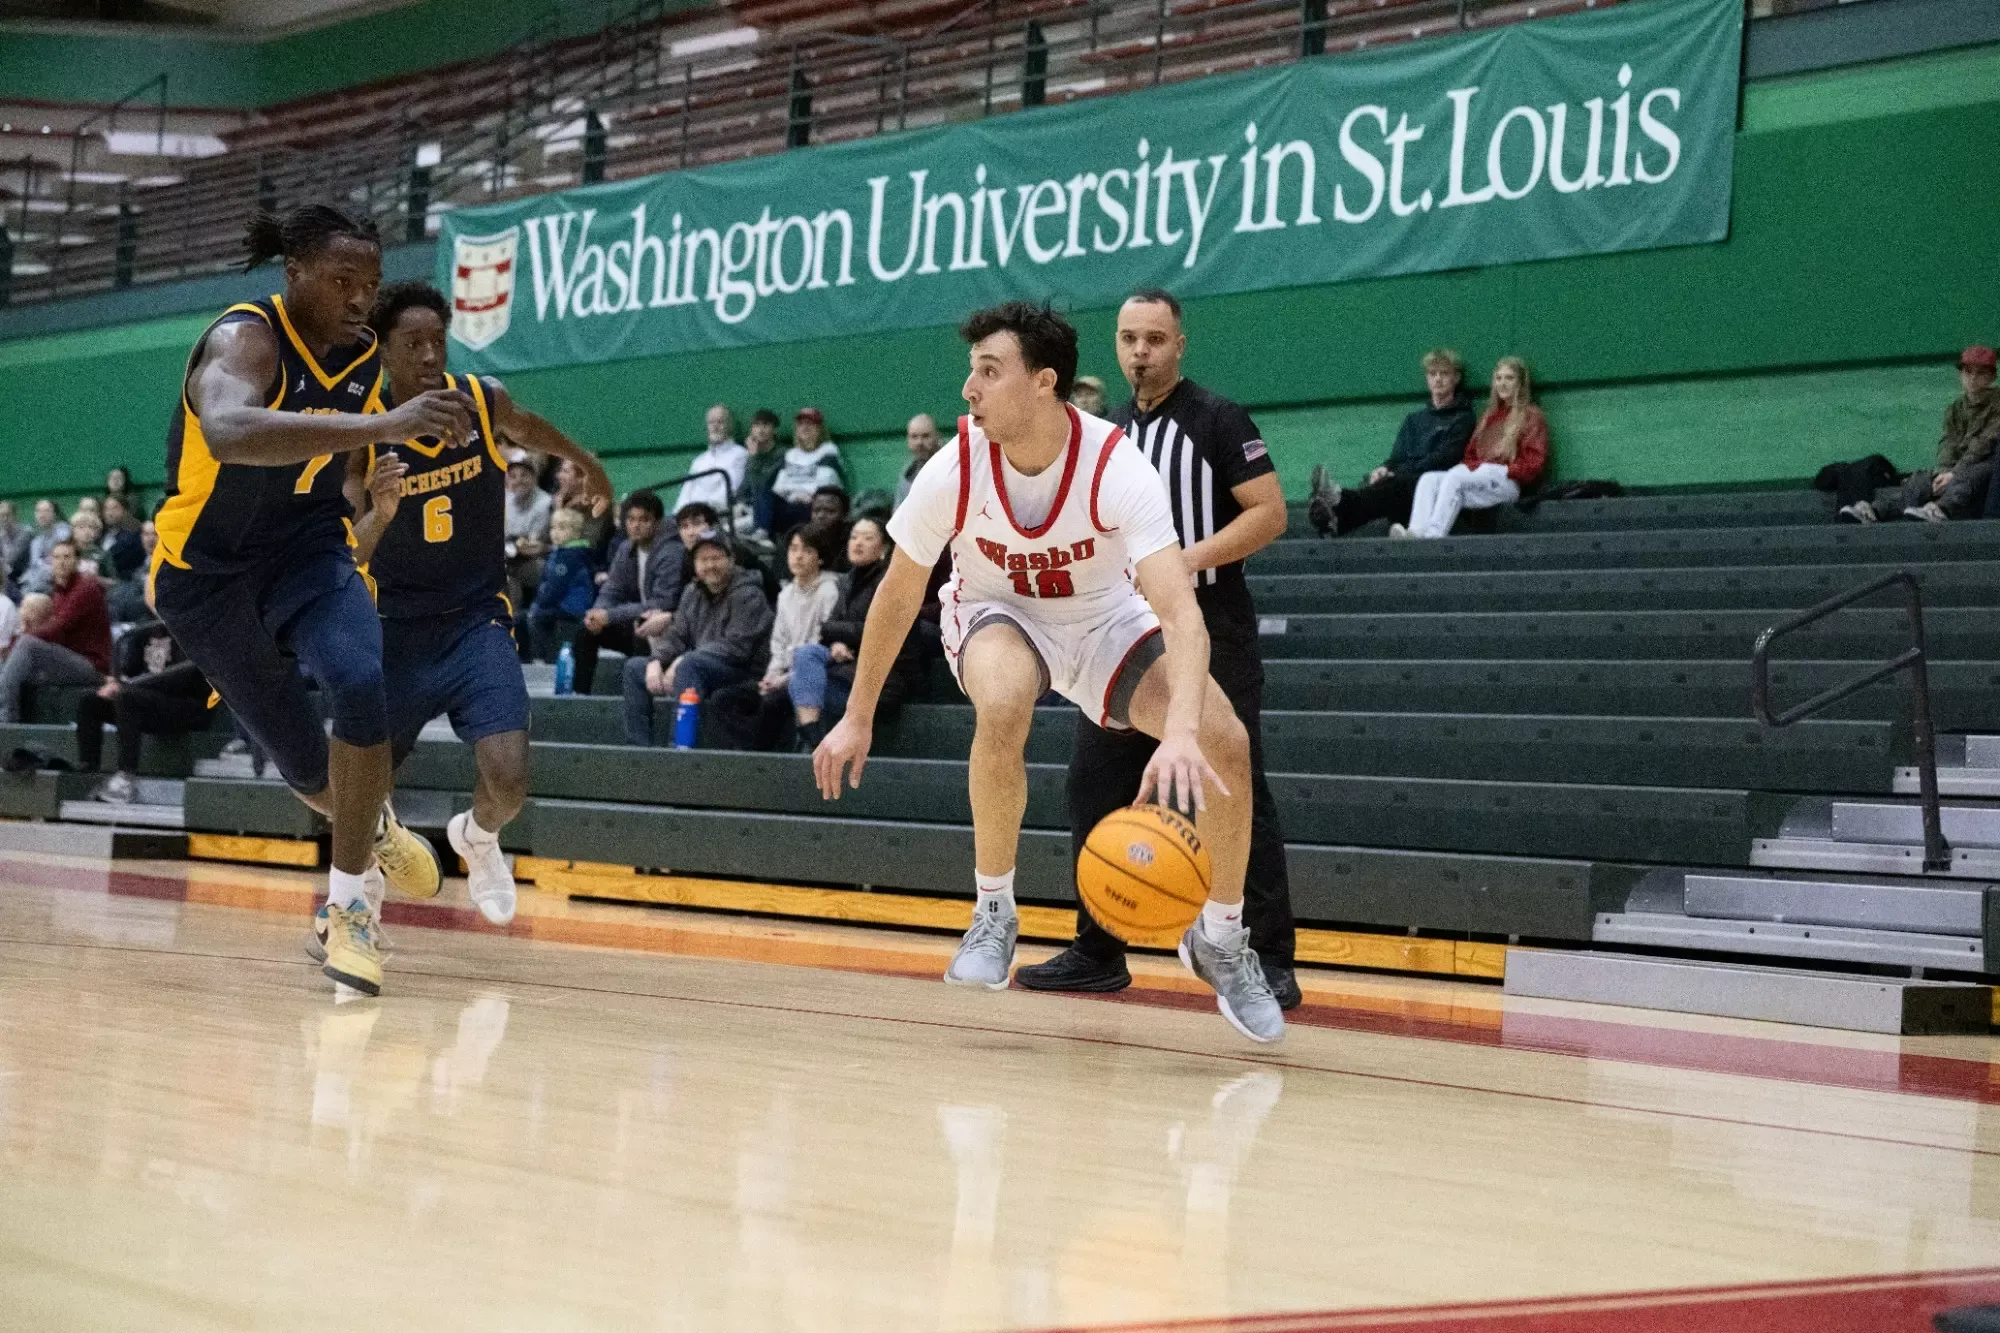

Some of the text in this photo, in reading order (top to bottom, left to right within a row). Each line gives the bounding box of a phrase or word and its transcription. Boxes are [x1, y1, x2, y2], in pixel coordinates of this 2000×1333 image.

[525, 62, 1682, 325] Washington University in St. Louis
[399, 454, 482, 498] OCHESTER
[423, 494, 453, 543] 6
[975, 537, 1096, 571] WashU
